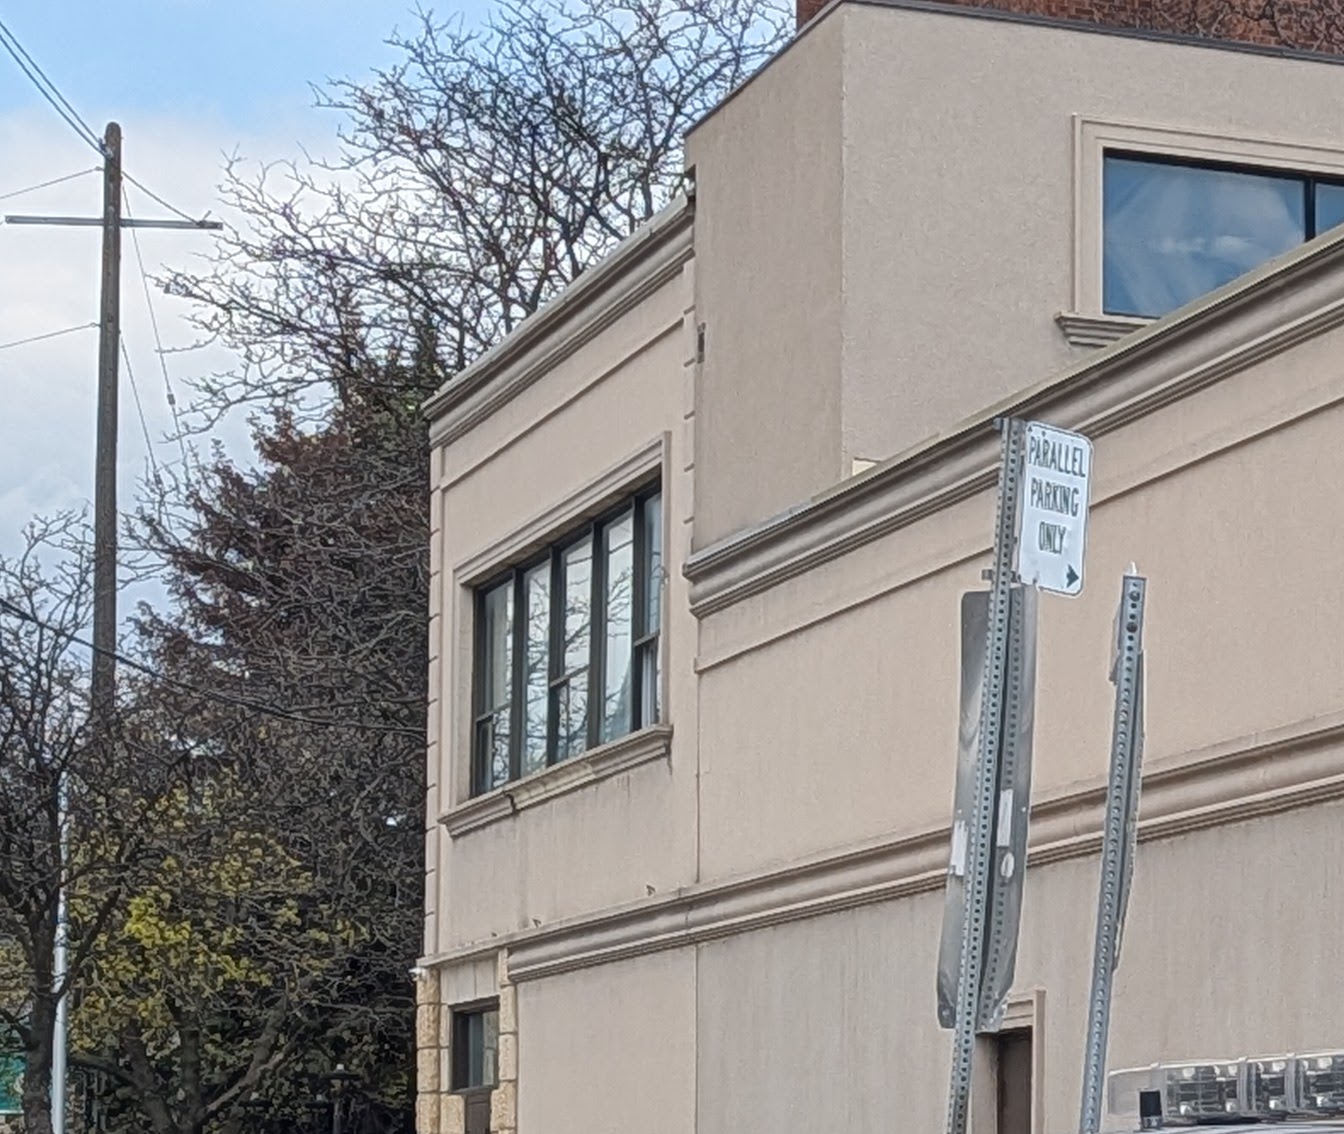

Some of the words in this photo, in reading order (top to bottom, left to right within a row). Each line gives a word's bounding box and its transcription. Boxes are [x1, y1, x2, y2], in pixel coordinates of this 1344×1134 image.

[1028, 435, 1086, 478] PARALLEL
[1030, 477, 1079, 518] PARKING
[1038, 521, 1066, 554] ONLY
